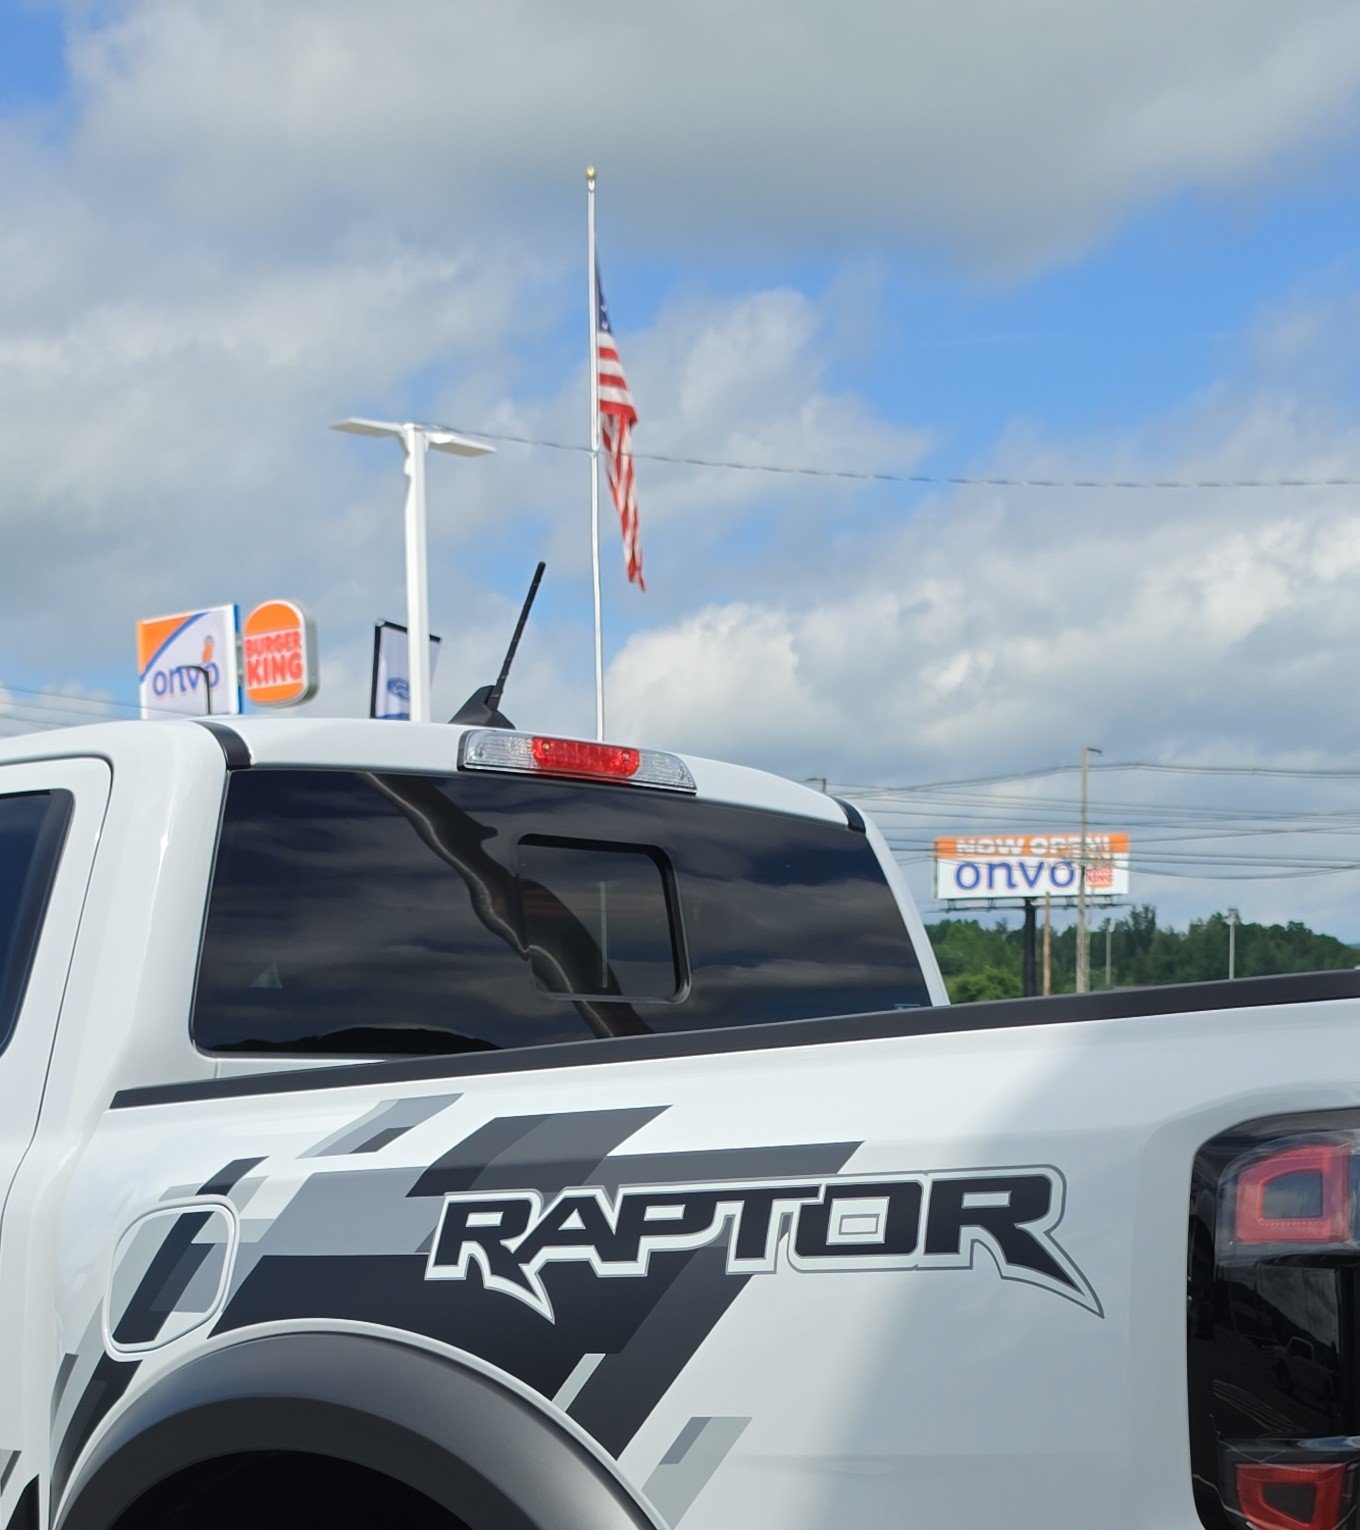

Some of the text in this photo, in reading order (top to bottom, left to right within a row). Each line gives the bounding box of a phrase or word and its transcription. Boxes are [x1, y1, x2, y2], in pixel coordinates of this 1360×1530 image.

[245, 630, 301, 656] BURGER
[152, 661, 220, 697] onvo
[246, 652, 304, 687] KING
[956, 837, 1025, 855] NOW
[955, 861, 1076, 891] onvo
[424, 1164, 1105, 1324] RAPTOR
